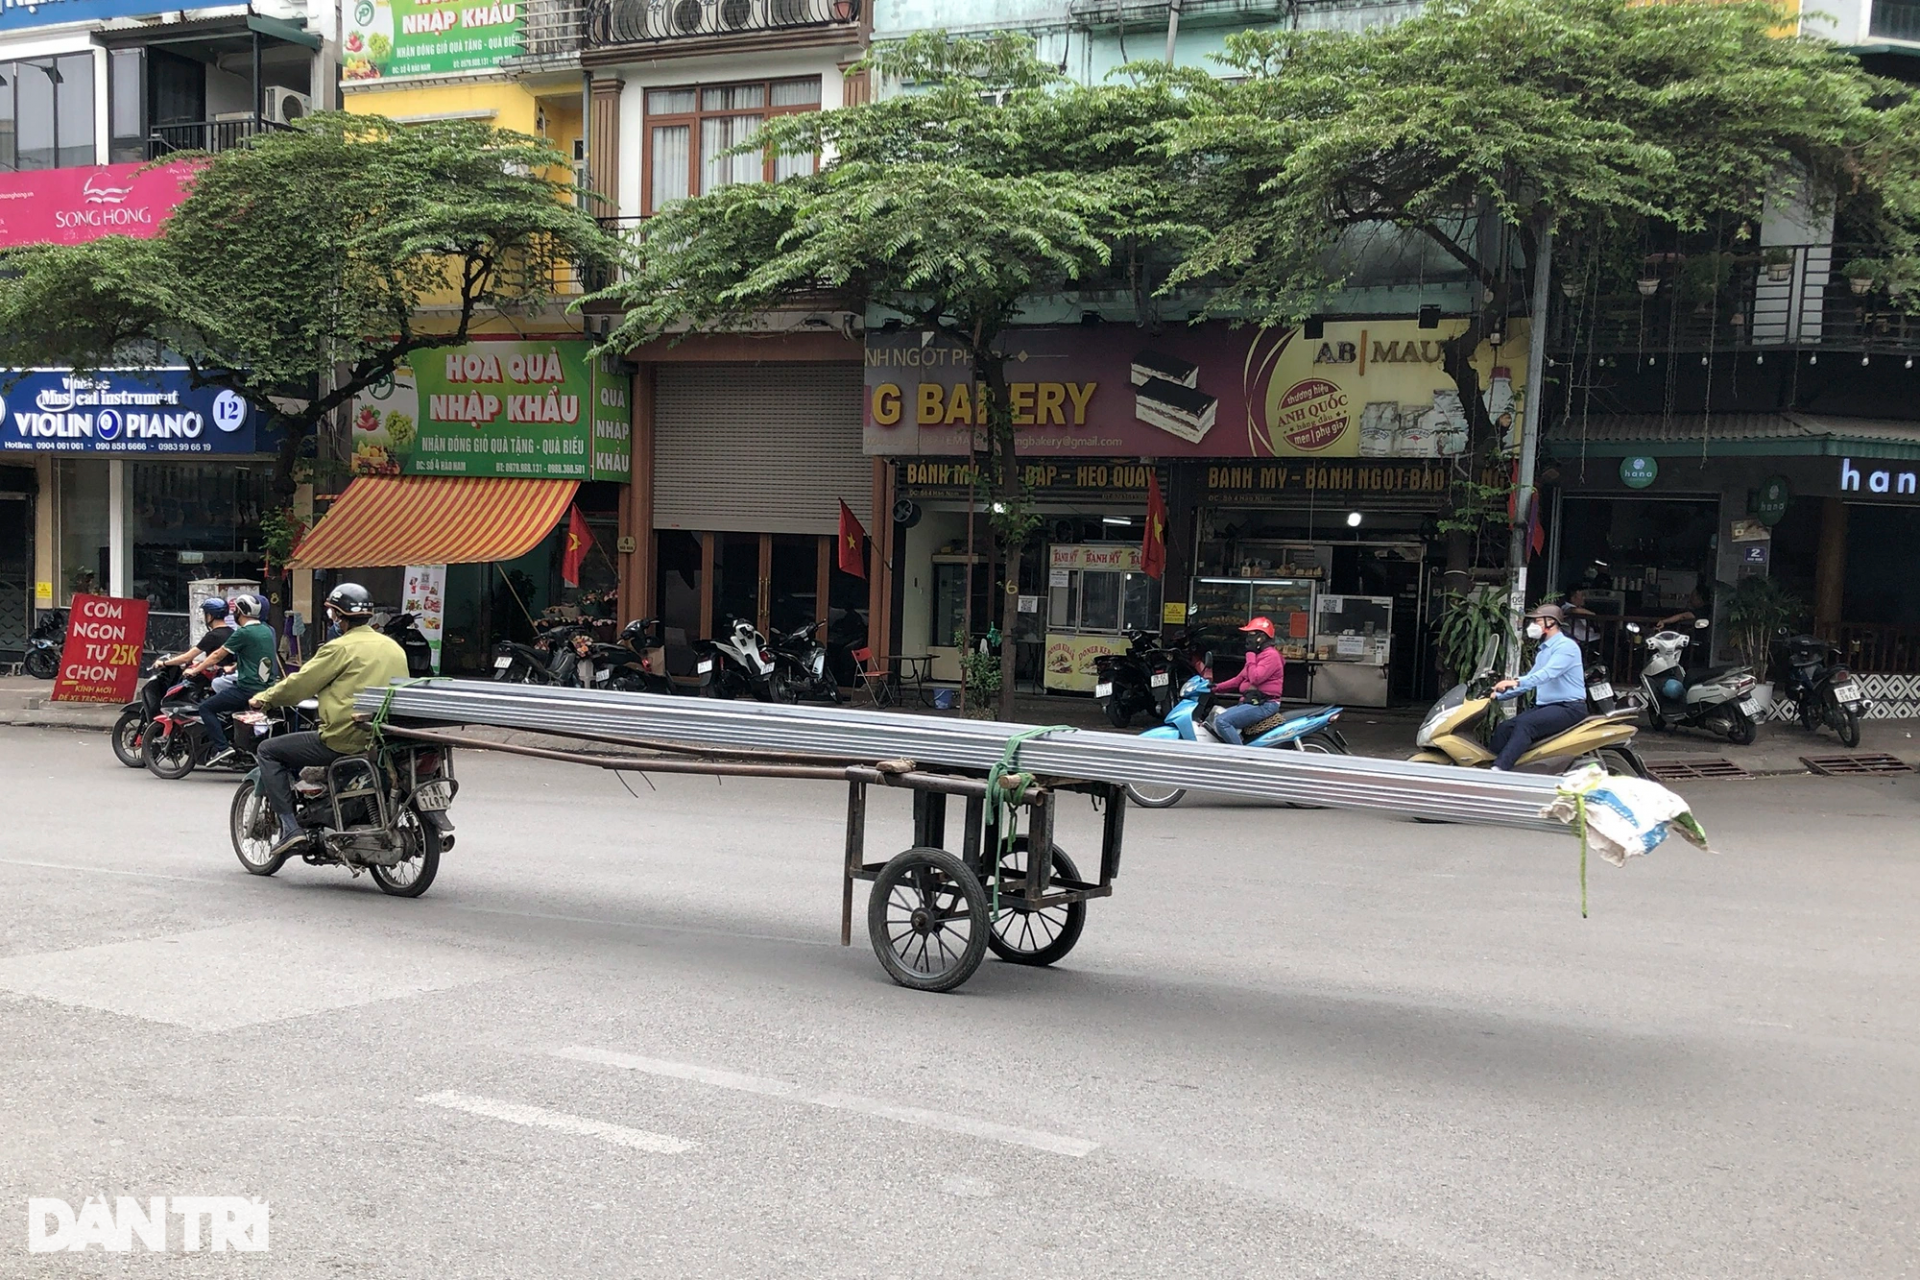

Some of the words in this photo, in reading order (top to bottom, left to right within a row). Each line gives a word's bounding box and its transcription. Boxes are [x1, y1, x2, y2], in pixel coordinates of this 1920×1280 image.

[402, 9, 457, 36] NHẬP
[893, 348, 948, 370] NGỌT
[1314, 341, 1356, 363] AB
[446, 353, 502, 382] HOA
[507, 346, 564, 383] QUẢ
[429, 389, 501, 427] NHẬP
[507, 385, 579, 422] KHẨU
[600, 386, 626, 409] QUẢ
[872, 383, 902, 425] G
[218, 401, 239, 420] 12
[1277, 408, 1307, 428] ANH
[1308, 394, 1349, 418] QUỐC
[13, 412, 94, 438] VIOLIN
[126, 411, 205, 438] PIANO
[1294, 433, 1311, 445] men
[1315, 427, 1331, 442] phụ
[1331, 421, 1344, 435] gia
[4, 441, 33, 450] Hotline:
[36, 442, 55, 450] 0904
[57, 442, 70, 450] 061
[71, 442, 84, 450] 061
[95, 442, 110, 450] 090
[111, 442, 126, 450] 858
[127, 442, 147, 451] 6666
[158, 442, 178, 451] 0983
[179, 442, 189, 451] 99
[190, 442, 201, 451] 66
[203, 442, 212, 451] 19
[422, 434, 446, 455] NHẬN
[447, 435, 471, 453] ĐÓNG
[473, 433, 489, 452] GIỎ
[491, 435, 508, 454] QUÀ
[511, 436, 534, 457] TẶNG
[542, 436, 560, 455] QUÀ
[562, 434, 584, 454] BIẾU
[435, 459, 440, 471] 4
[596, 447, 629, 473] KHẨU
[907, 460, 949, 485] BÁNH
[1077, 465, 1108, 487] HEO
[1305, 462, 1353, 490] BÁNH
[1624, 469, 1653, 478] hana
[1841, 458, 1917, 494] han
[1750, 548, 1762, 558] 2
[270, 592, 279, 604] 8
[1006, 579, 1019, 595] 6
[83, 601, 123, 620] CƠM
[73, 621, 126, 641] NGON
[85, 643, 111, 664] TỰ
[109, 643, 140, 666] 25K
[65, 664, 118, 683] CHỌN
